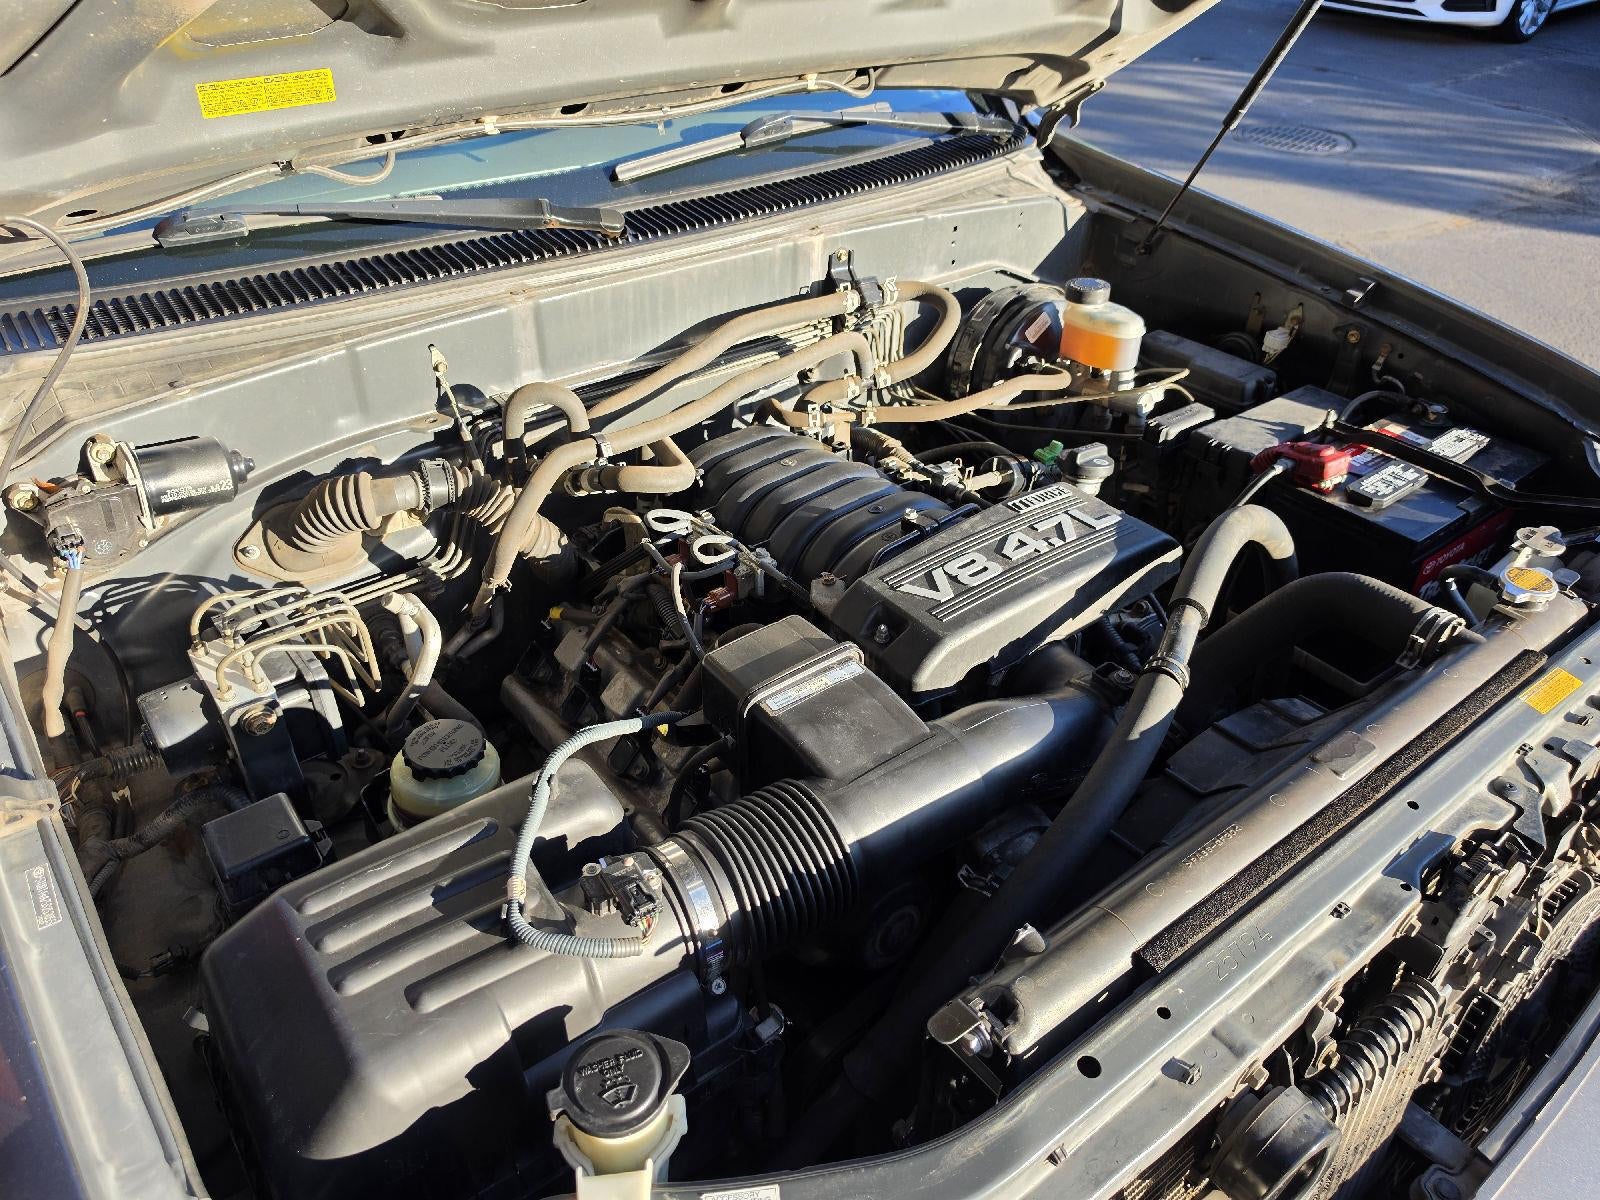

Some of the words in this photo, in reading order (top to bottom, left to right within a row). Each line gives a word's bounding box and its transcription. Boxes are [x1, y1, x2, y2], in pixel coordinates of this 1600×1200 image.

[897, 551, 1003, 604] V8
[1001, 509, 1123, 562] 4.7L
[578, 1058, 616, 1077] WASHER
[614, 1047, 643, 1065] FLUID
[602, 1063, 625, 1078] ONLY
